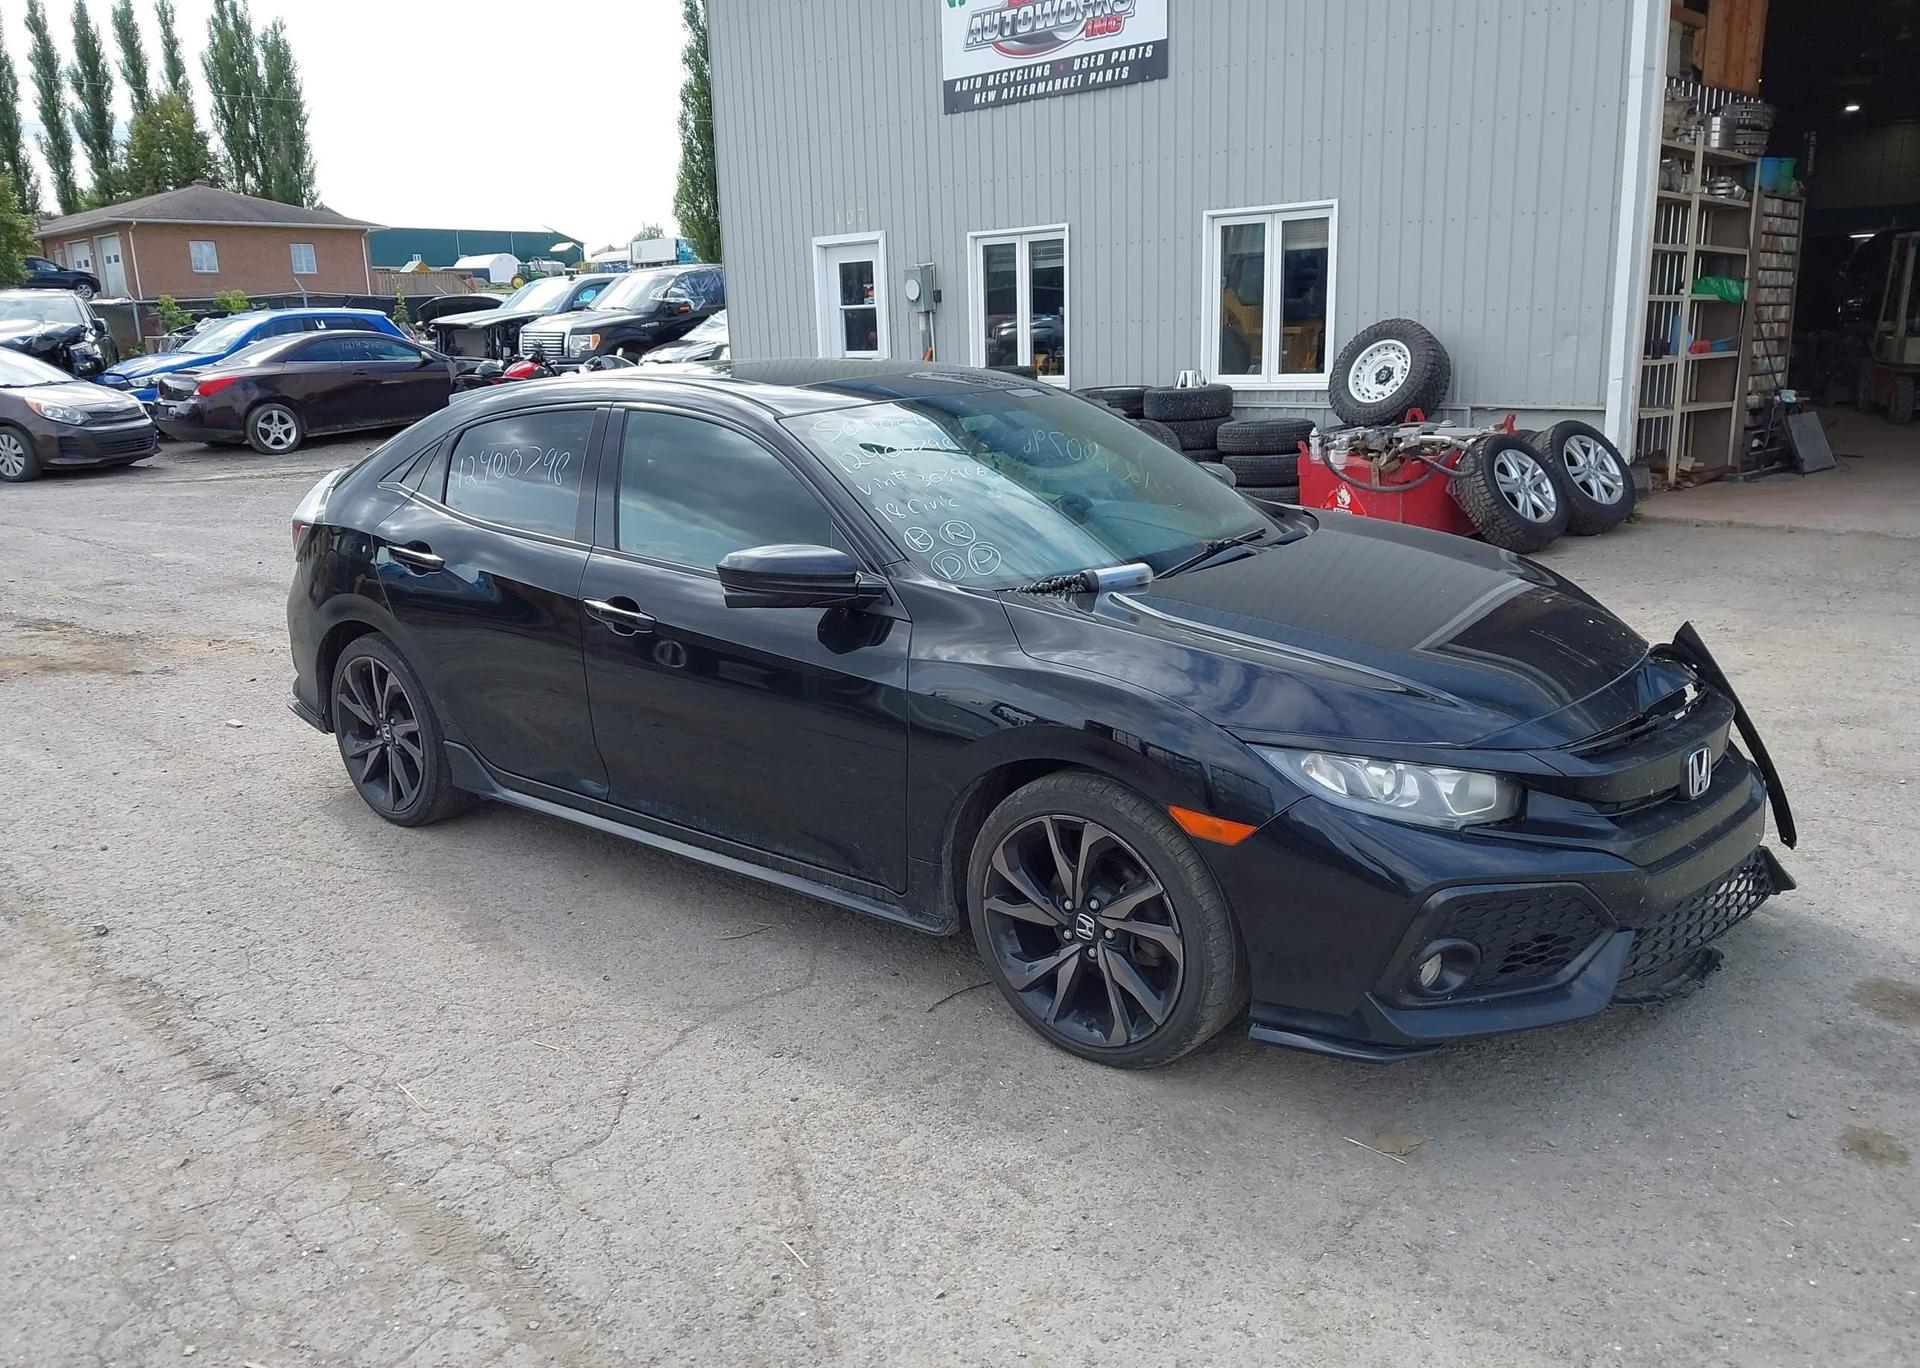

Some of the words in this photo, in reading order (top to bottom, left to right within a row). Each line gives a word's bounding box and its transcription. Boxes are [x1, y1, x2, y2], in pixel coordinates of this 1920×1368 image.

[1085, 14, 1122, 38] INC
[954, 76, 982, 92] AUTO
[987, 64, 1051, 86] RECYCLING
[1073, 53, 1105, 71] USED
[1110, 45, 1154, 64] PARTS
[973, 90, 997, 105] NEW
[1002, 74, 1083, 100] AFTERMARKET
[1088, 66, 1130, 85] PARTS
[836, 208, 865, 225] 107
